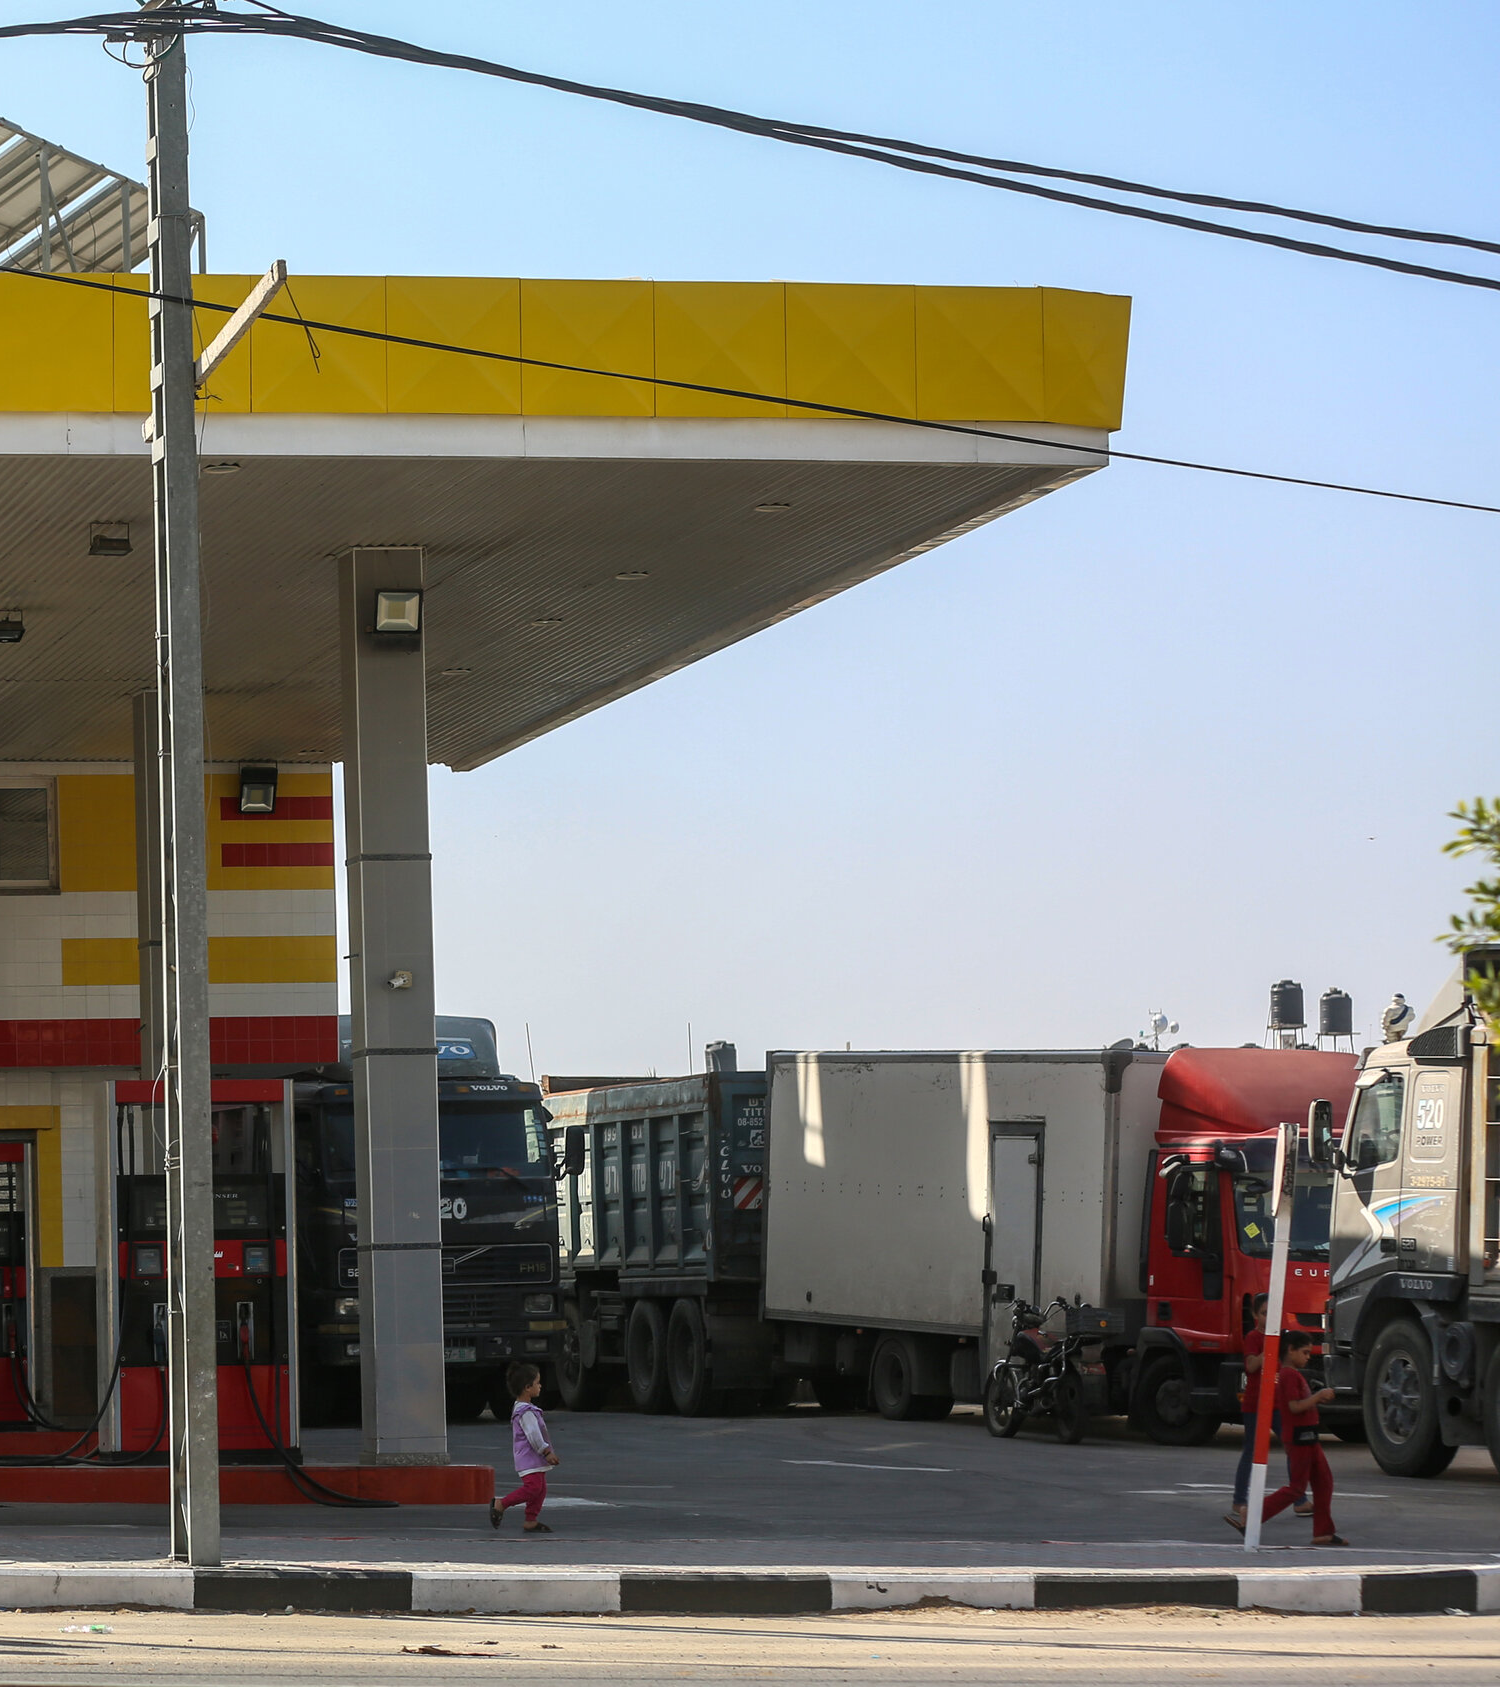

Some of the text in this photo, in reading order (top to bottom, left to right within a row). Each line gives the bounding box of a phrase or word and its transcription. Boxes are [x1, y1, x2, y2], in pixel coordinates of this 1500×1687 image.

[743, 1108, 765, 1116] TIT
[1417, 1099, 1444, 1130] 520
[737, 1117, 764, 1127] 08-852
[1416, 1136, 1443, 1146] POWER
[440, 1197, 467, 1220] 20
[347, 1268, 359, 1277] 52
[1399, 1278, 1433, 1290] VOLVO
